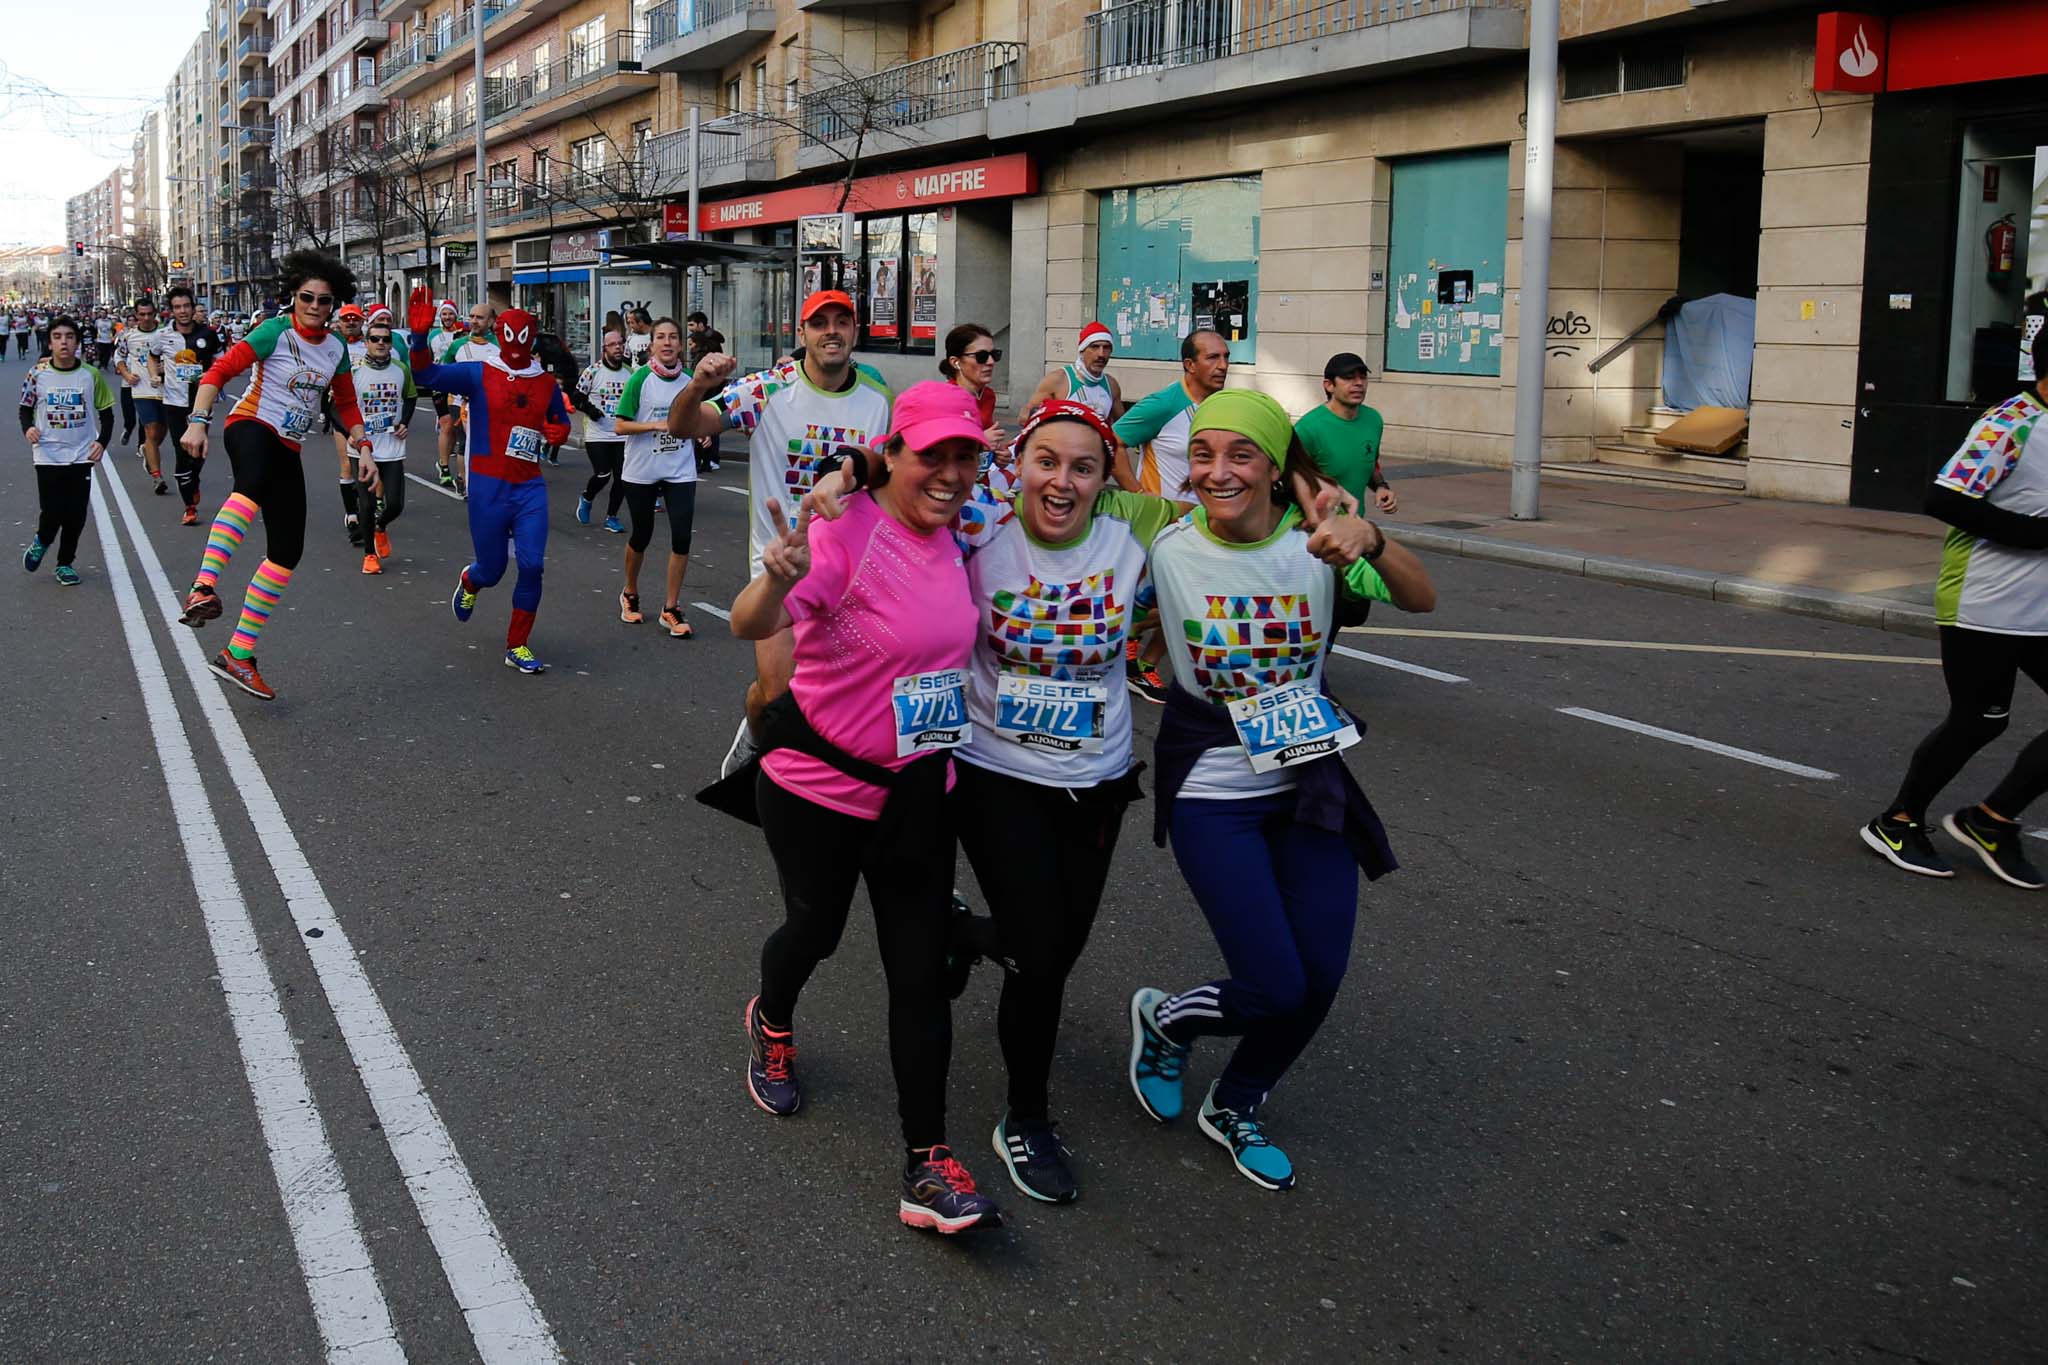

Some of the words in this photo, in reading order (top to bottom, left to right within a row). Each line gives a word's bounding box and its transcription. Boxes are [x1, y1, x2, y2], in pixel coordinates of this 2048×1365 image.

[914, 167, 985, 198] MAPFRE
[720, 201, 763, 222] MAPFRE
[573, 245, 600, 261] Calzado
[53, 392, 73, 405] 5174
[1205, 594, 1310, 619] XXXVI
[919, 672, 962, 690] SETEL
[1028, 683, 1097, 698] SETEL
[1260, 685, 1316, 710] SETE
[908, 688, 959, 728] 2773
[1011, 698, 1080, 732] 2772
[1250, 699, 1328, 747] 2429
[920, 732, 954, 742] ALJOMAR
[1027, 735, 1071, 750] ALJOMAR
[1284, 742, 1331, 759] ALJOMAR
